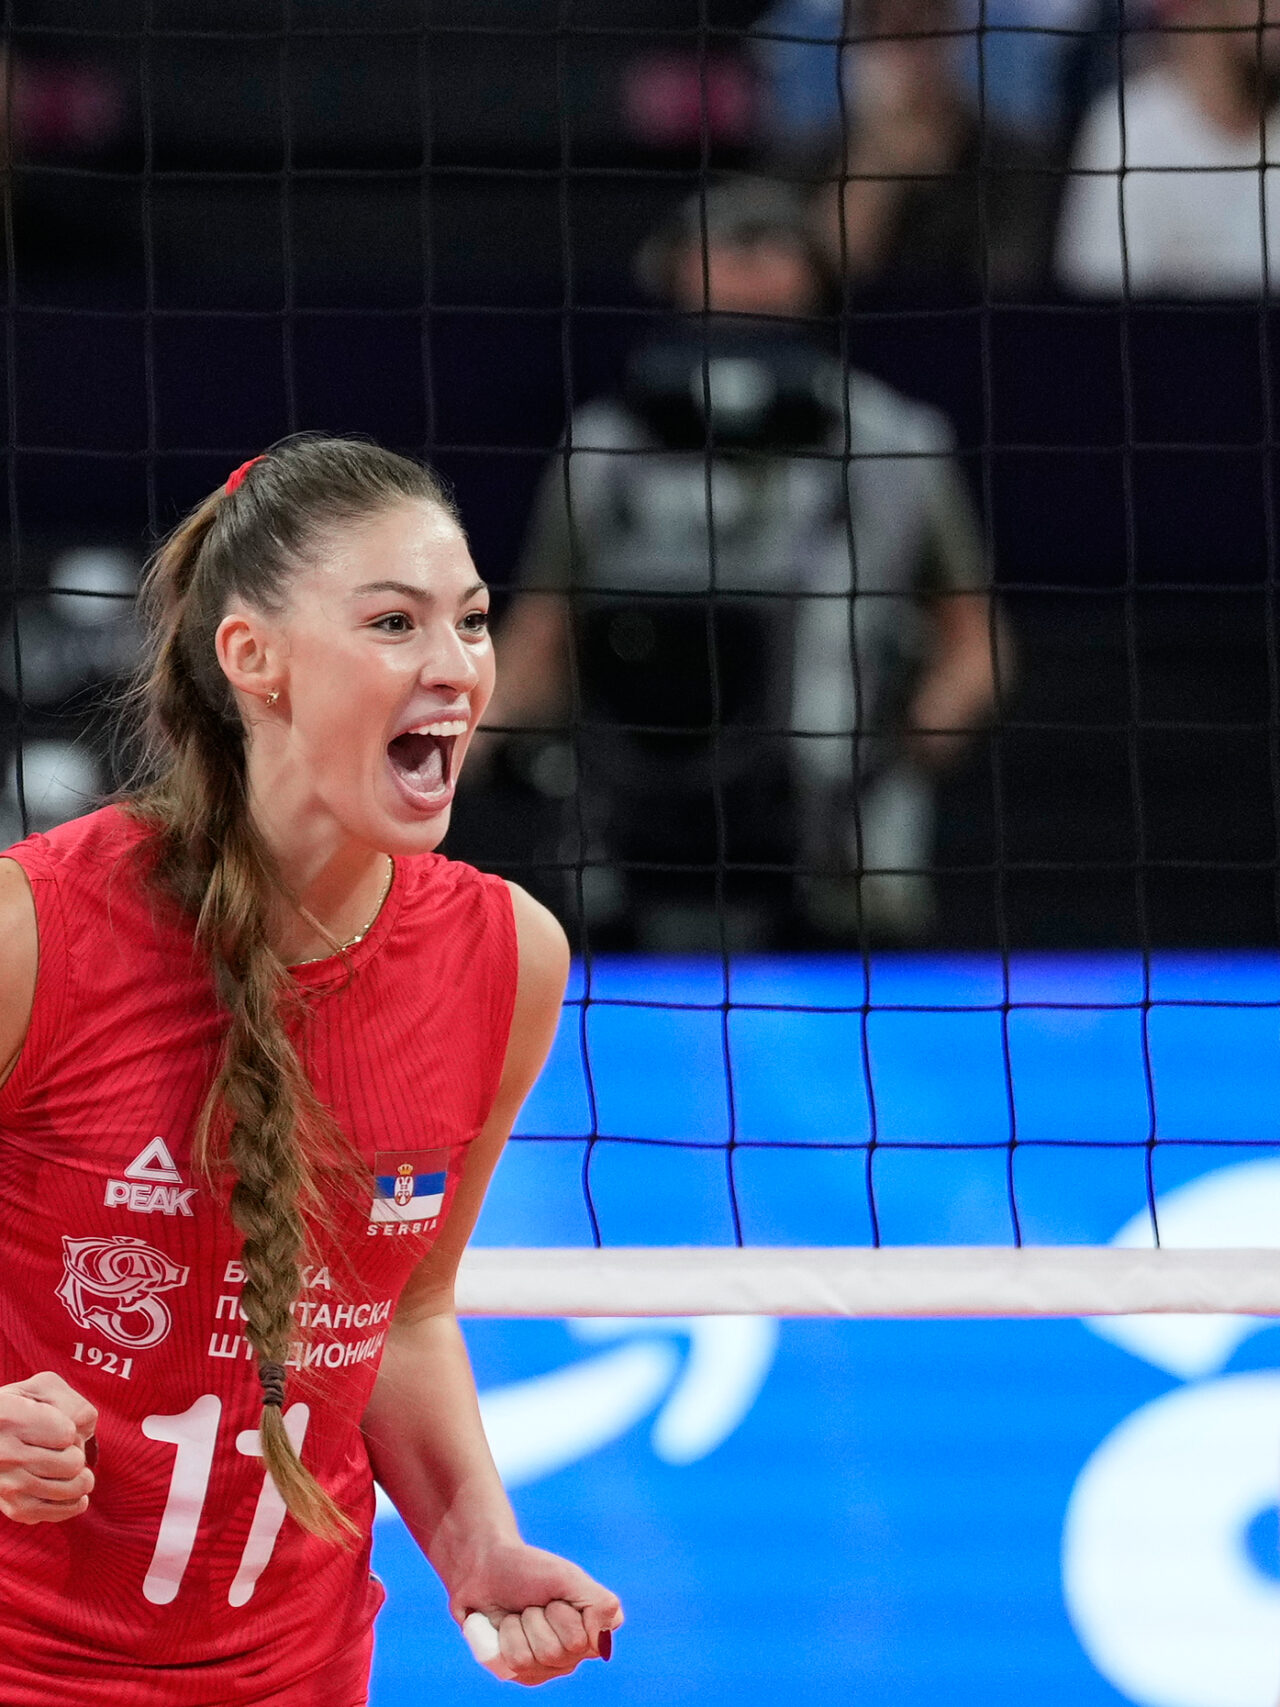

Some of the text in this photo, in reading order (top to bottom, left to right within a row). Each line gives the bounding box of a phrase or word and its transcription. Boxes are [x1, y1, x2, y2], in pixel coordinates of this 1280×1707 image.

[103, 1178, 200, 1217] PEAK
[366, 1219, 438, 1236] SERBIA
[223, 1260, 331, 1290] БКА
[215, 1295, 392, 1329] ПТАНСКА
[71, 1342, 134, 1380] 1921
[141, 1393, 311, 1608] 11
